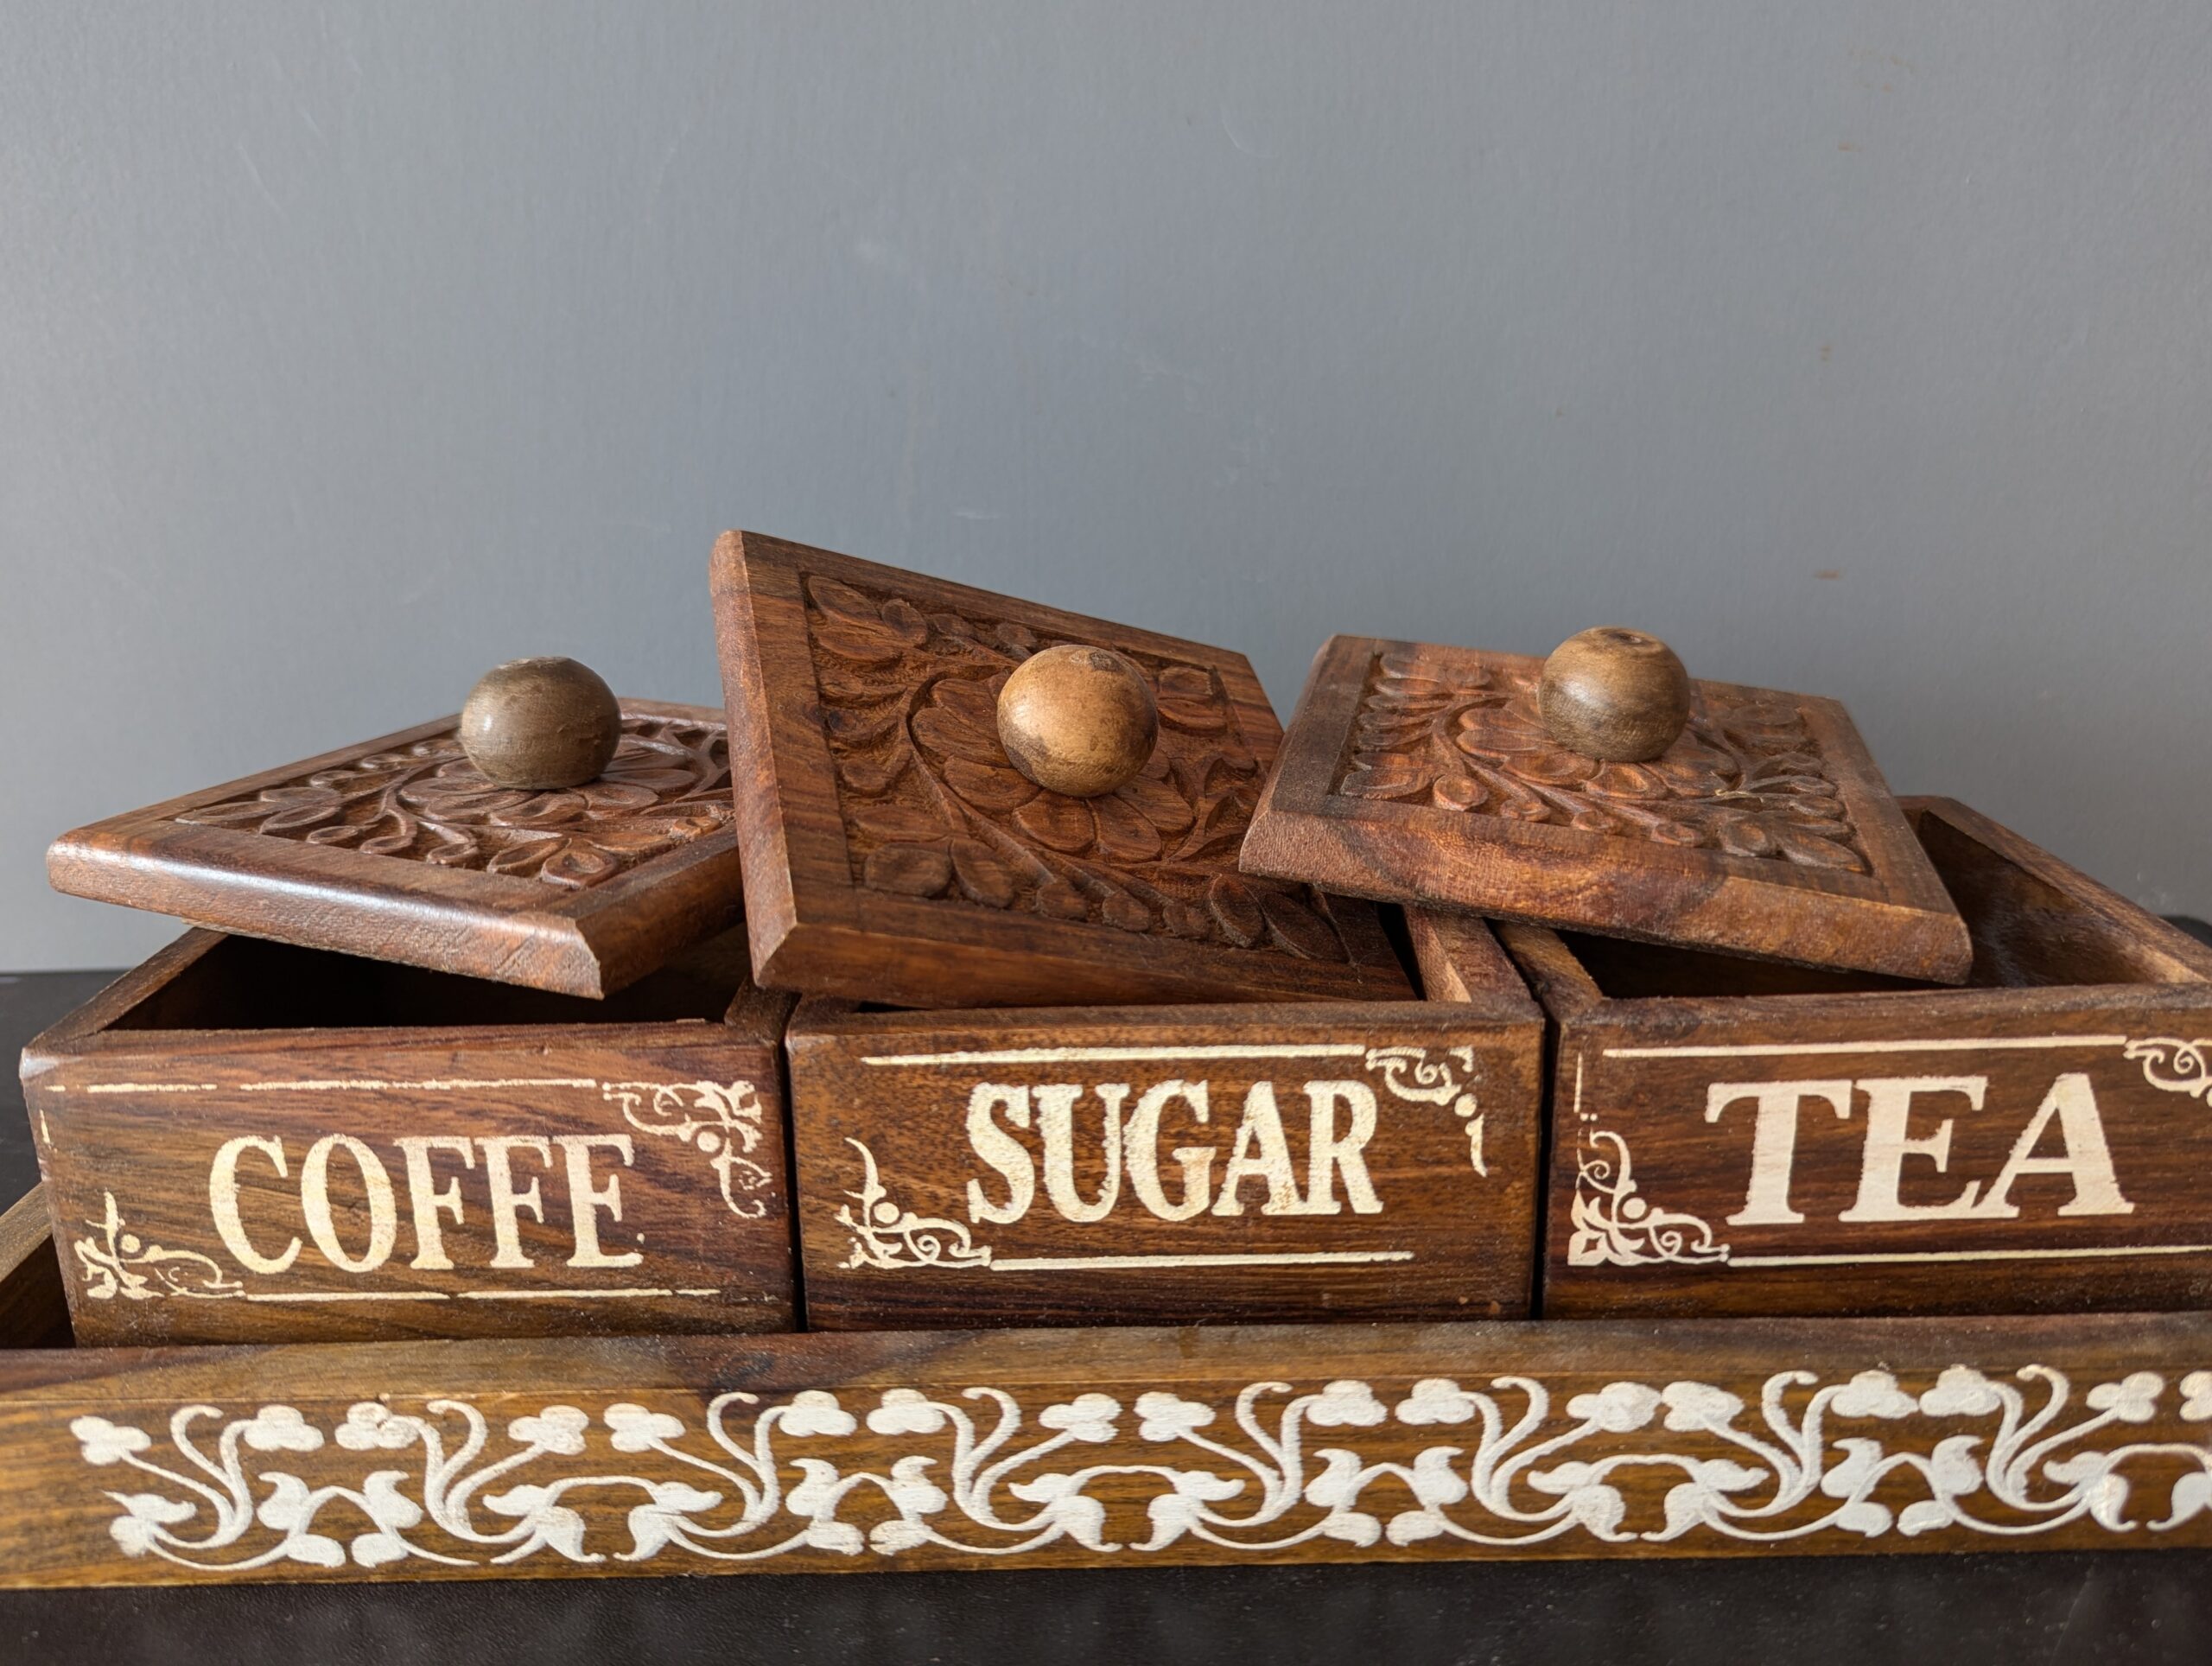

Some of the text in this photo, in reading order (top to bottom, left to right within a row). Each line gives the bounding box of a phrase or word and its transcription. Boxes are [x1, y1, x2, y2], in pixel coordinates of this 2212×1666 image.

[209, 1133, 645, 1275] COFFE
[965, 1078, 1384, 1224] SUGAR
[1704, 1072, 2136, 1226] TEA
